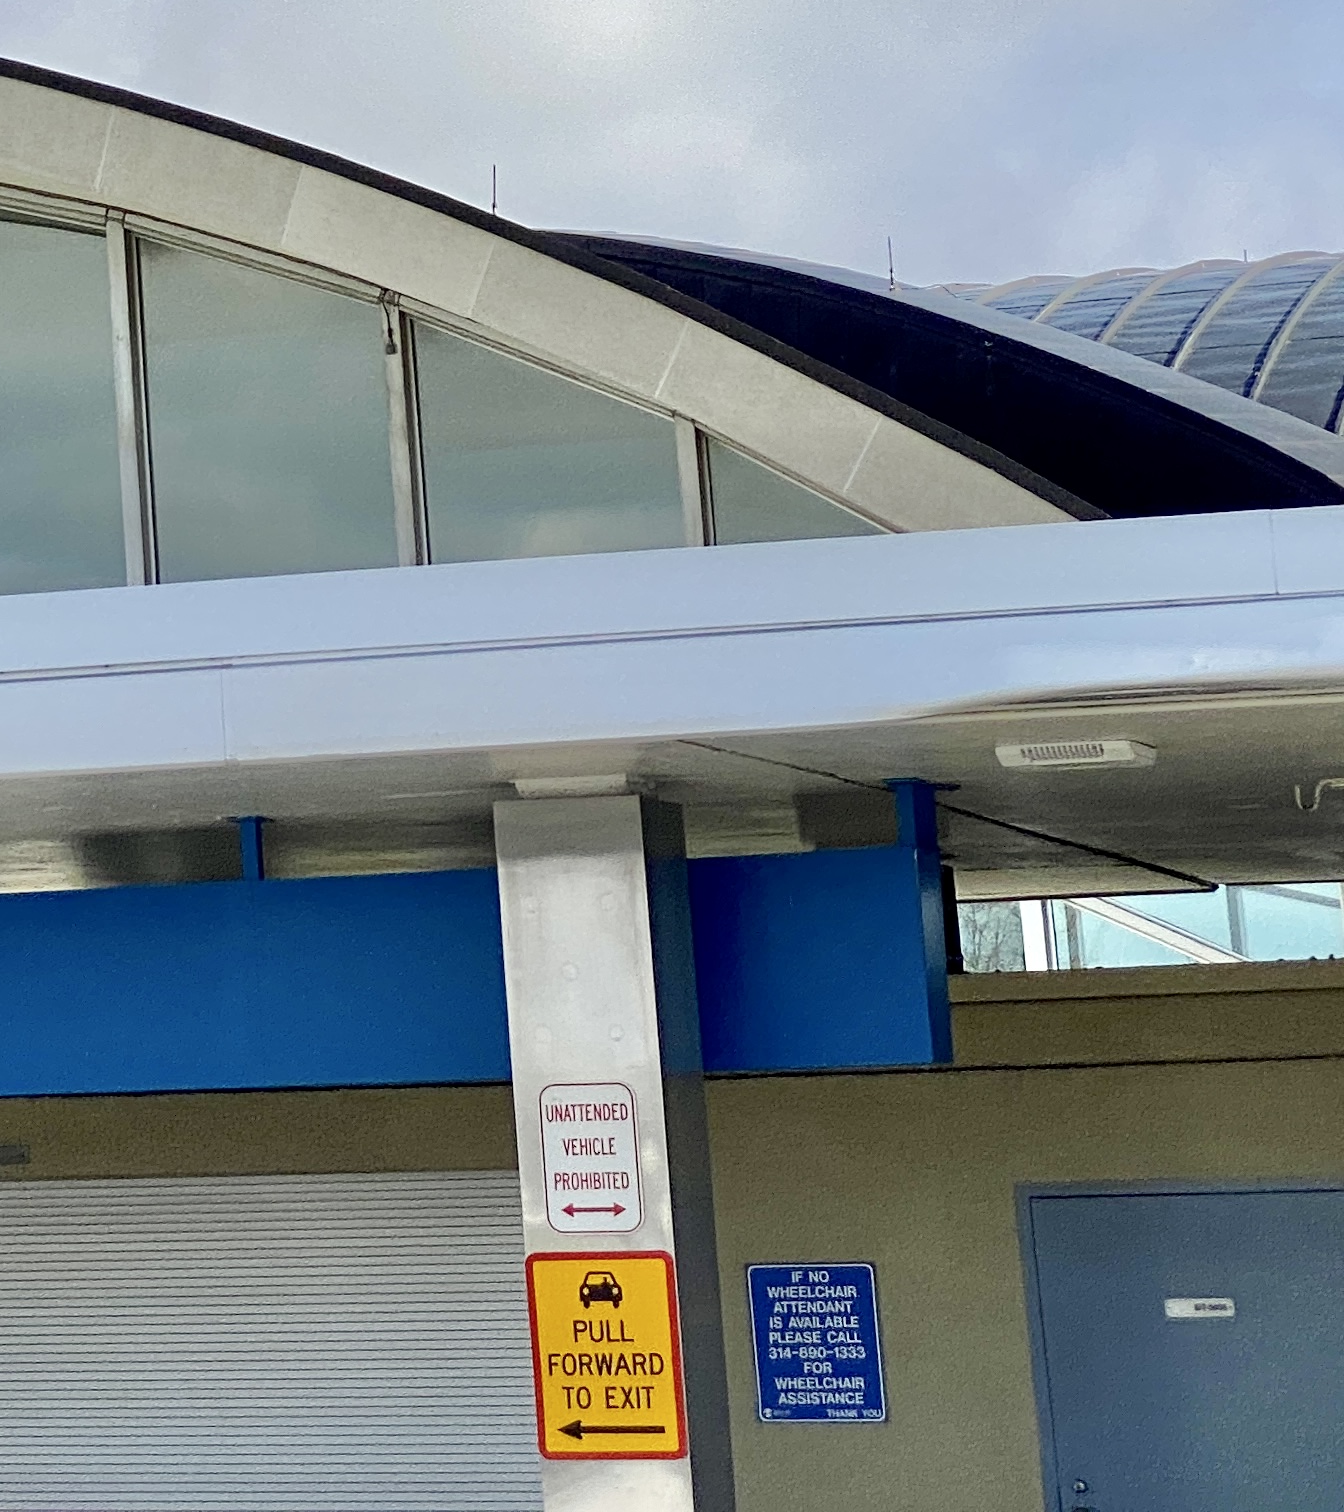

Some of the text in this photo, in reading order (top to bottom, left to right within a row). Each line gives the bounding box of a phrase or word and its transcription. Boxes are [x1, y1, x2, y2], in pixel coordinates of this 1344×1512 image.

[545, 1103, 629, 1123] UNATTENDED
[562, 1137, 617, 1156] VEHICLE
[554, 1171, 630, 1190] PROHIBITED
[791, 1270, 830, 1283] IF NO
[767, 1285, 857, 1298] WHEELCHAIR
[773, 1301, 853, 1314] ATTENDANT
[769, 1316, 859, 1329] IS AVAILABLE
[572, 1319, 635, 1343] PULL
[769, 1331, 862, 1344] PLEASE CALL
[768, 1346, 866, 1359] 314-890-1333
[547, 1353, 665, 1376] FORWARD
[804, 1362, 832, 1374] FOR
[774, 1377, 865, 1390] WHEELCHAIR
[561, 1386, 655, 1410] TO EXIT
[778, 1392, 864, 1405] ASSISTANCE
[863, 1409, 882, 1417] YOU
